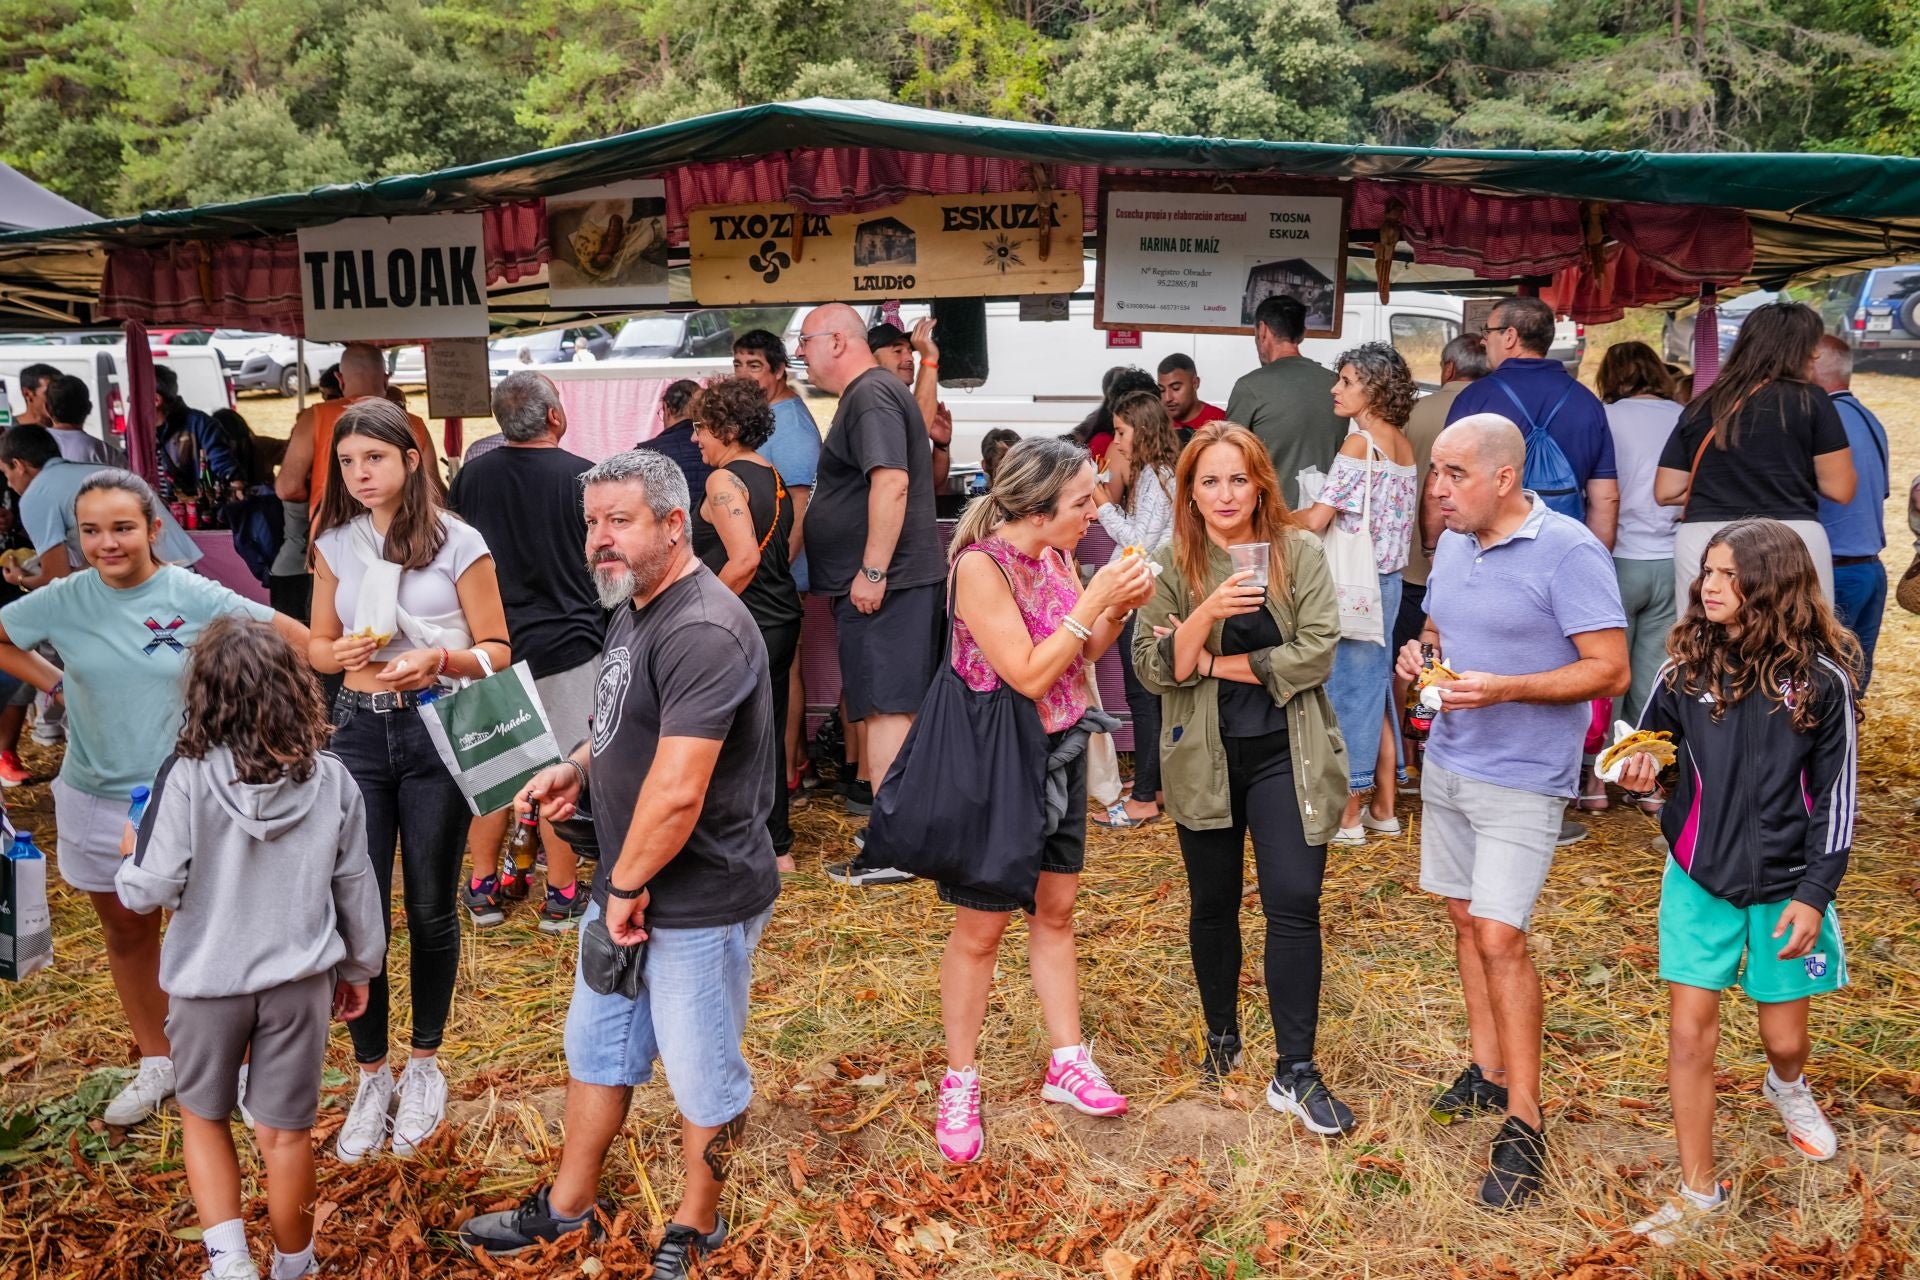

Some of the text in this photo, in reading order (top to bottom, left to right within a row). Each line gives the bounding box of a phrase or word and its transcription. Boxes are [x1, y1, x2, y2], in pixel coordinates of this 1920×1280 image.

[1115, 208, 1247, 222] Cosecha propia y elaboración artesanal
[1269, 212, 1311, 223] TXOSNA
[1269, 229, 1310, 240] ESKUZA
[1140, 236, 1220, 254] HARINA DE MAÍZ
[1152, 267, 1181, 277] Registro
[1183, 268, 1213, 277] Obrador
[304, 246, 482, 310] TALOAK
[1203, 304, 1227, 312] Laudio
